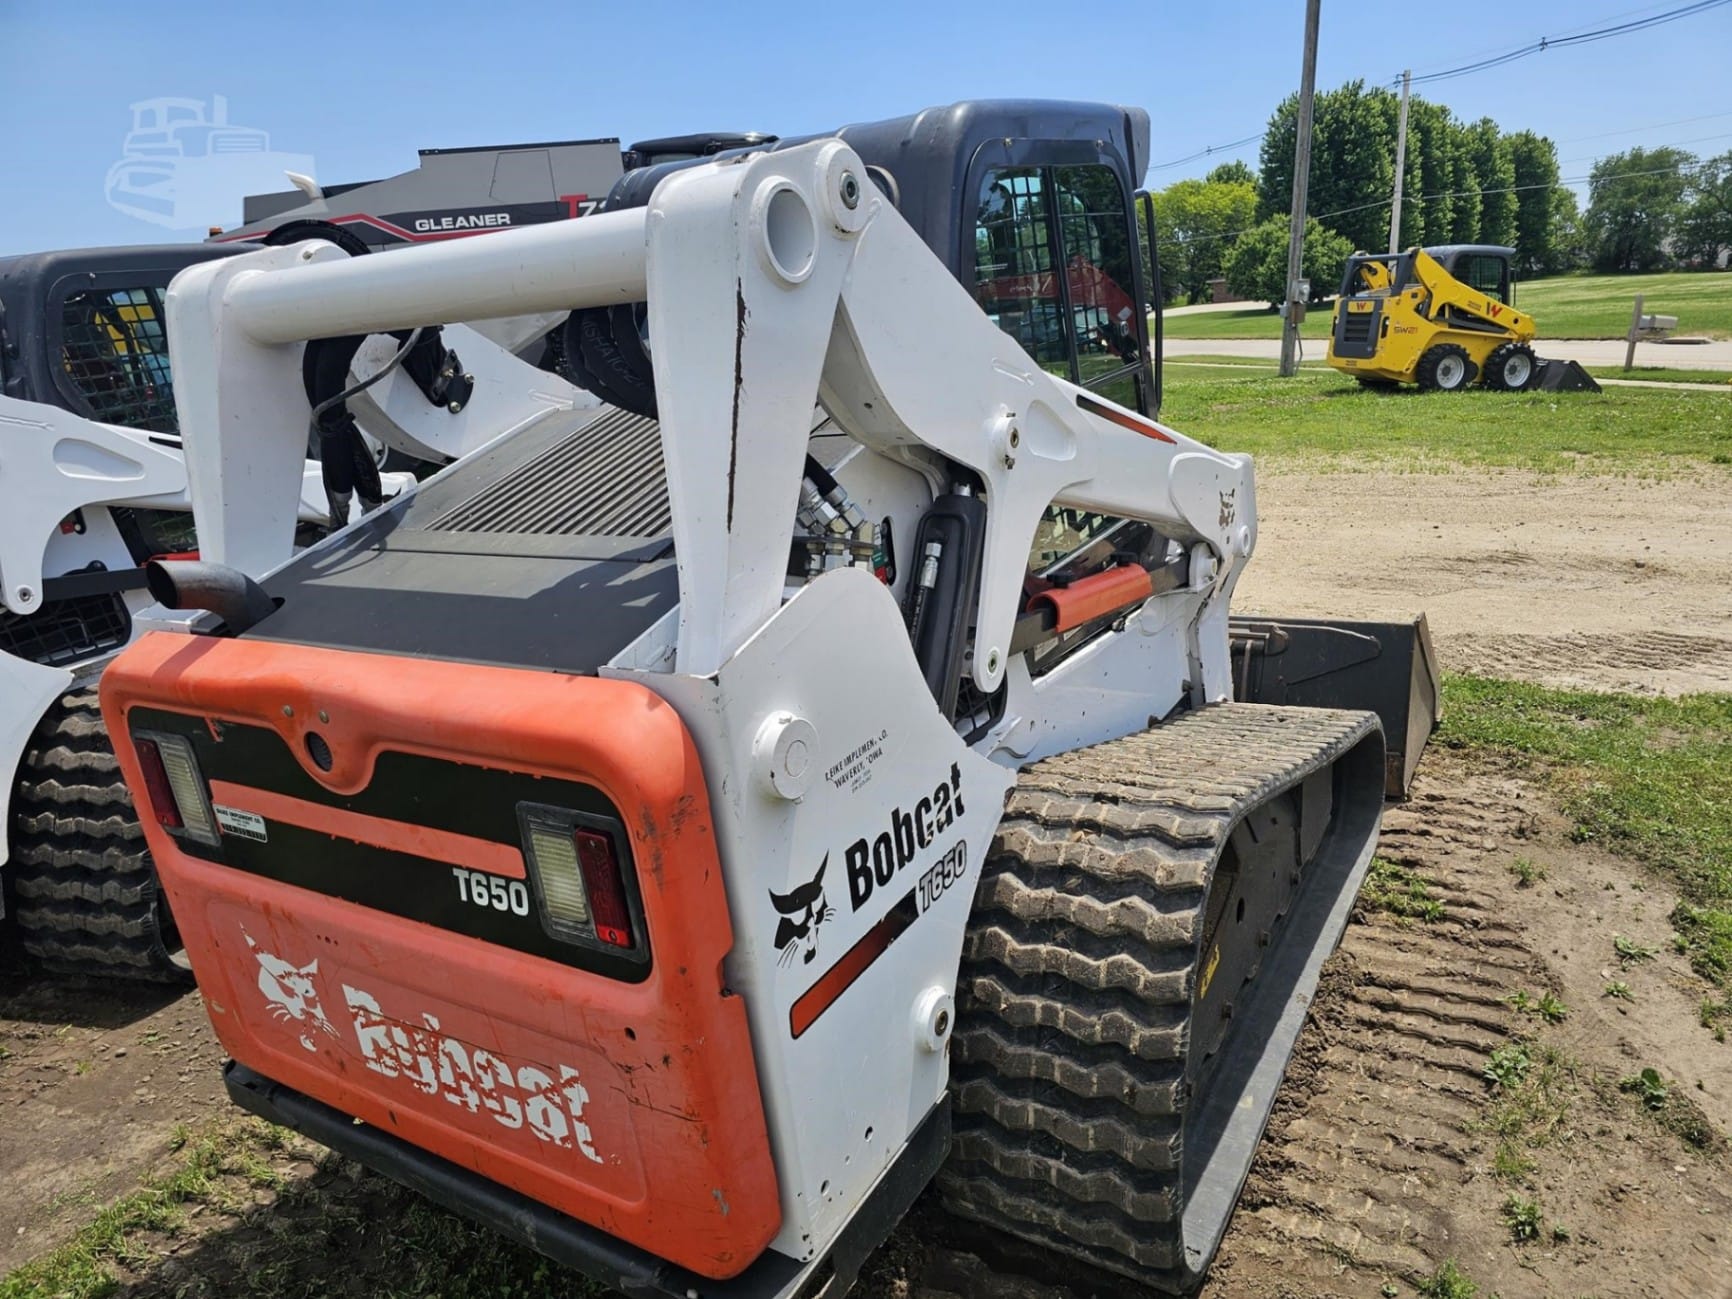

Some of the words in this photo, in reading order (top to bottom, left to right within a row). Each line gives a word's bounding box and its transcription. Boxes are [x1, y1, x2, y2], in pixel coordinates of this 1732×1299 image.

[415, 212, 511, 231] GLEANER
[560, 193, 607, 219] T7
[843, 737, 877, 767] IMPLEMEN
[844, 761, 965, 913] Bobcat
[453, 867, 529, 917] T650
[919, 839, 967, 914] T650
